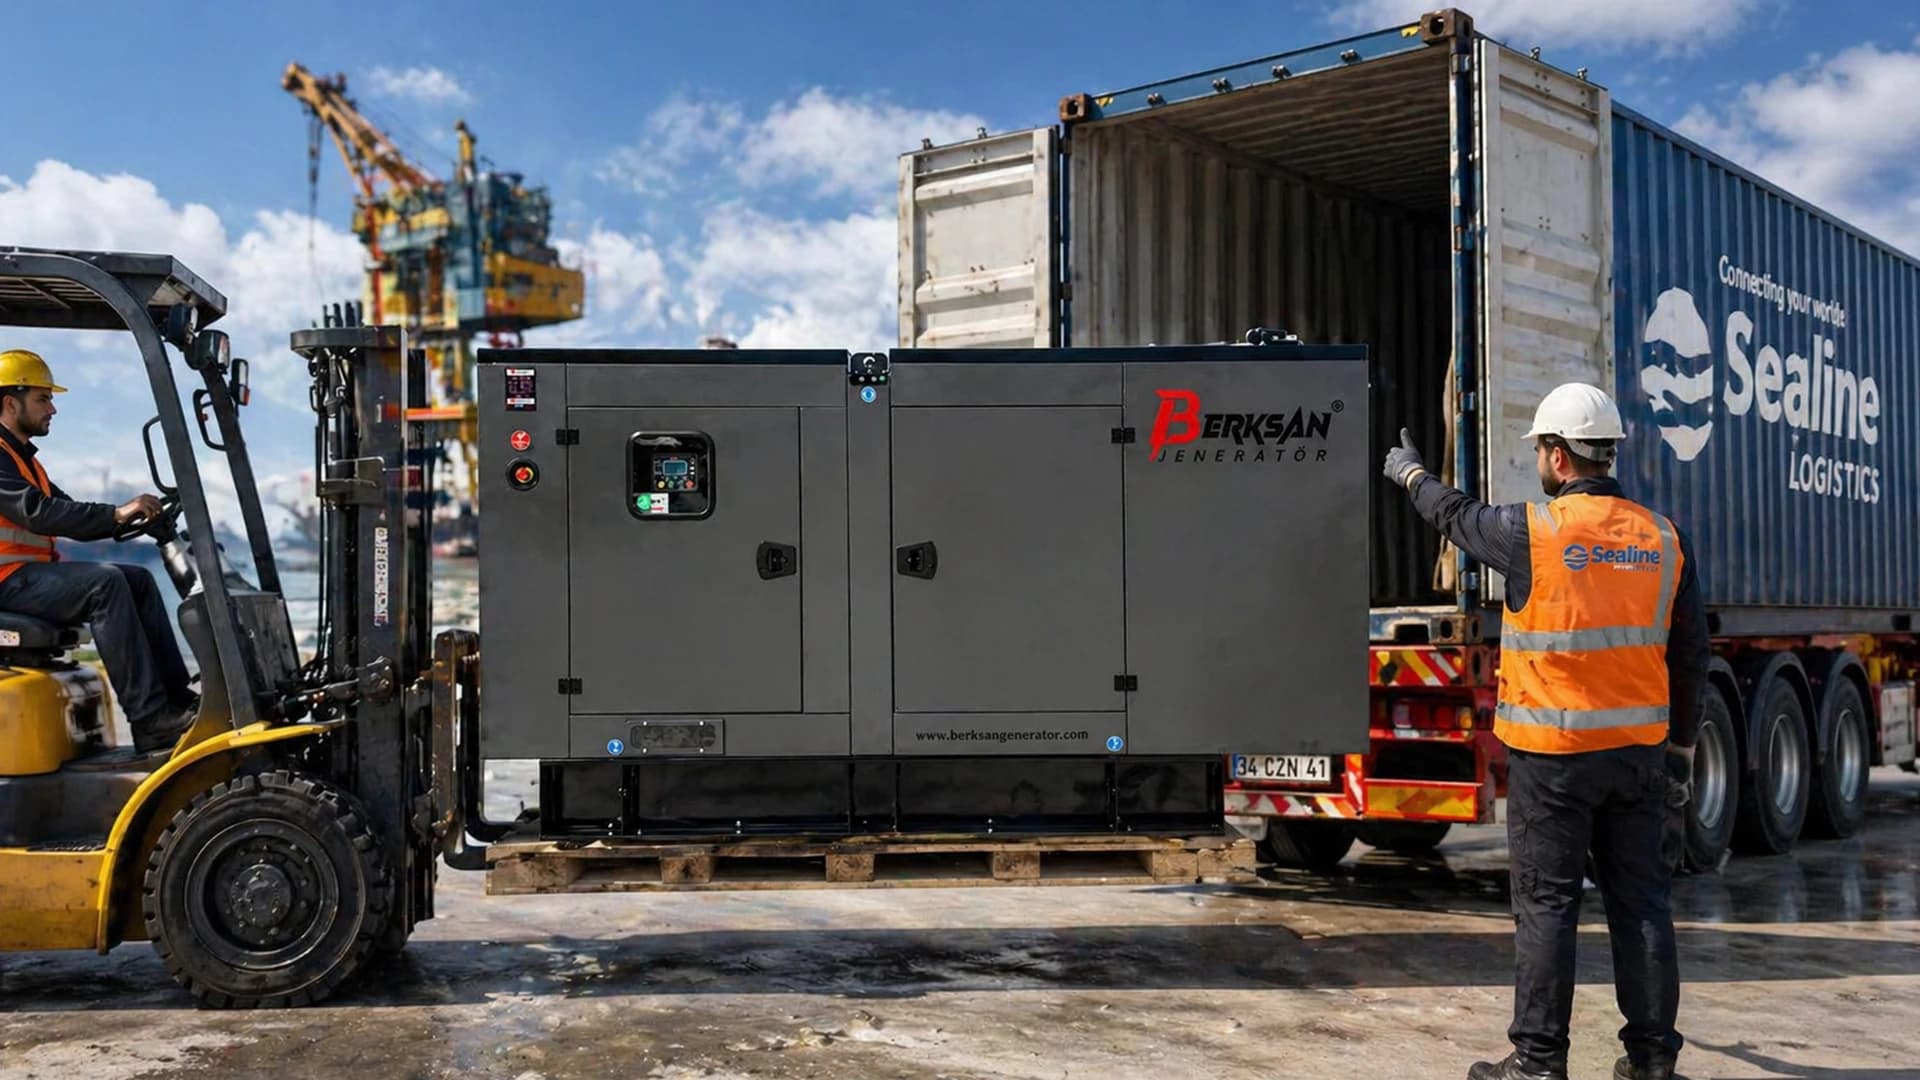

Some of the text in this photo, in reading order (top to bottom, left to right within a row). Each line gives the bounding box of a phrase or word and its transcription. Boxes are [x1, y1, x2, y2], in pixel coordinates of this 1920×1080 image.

[1719, 255, 1784, 312] Connecting
[1787, 288, 1811, 315] your
[1723, 310, 1880, 445] Sealine
[1157, 445, 1328, 463] JENERATÖR
[1789, 451, 1880, 504] LOGISTICS
[1591, 545, 1661, 564] Sealine
[916, 729, 1089, 743] www.berksangenerator.com
[1238, 757, 1257, 776] 34
[1306, 758, 1326, 778] 41
